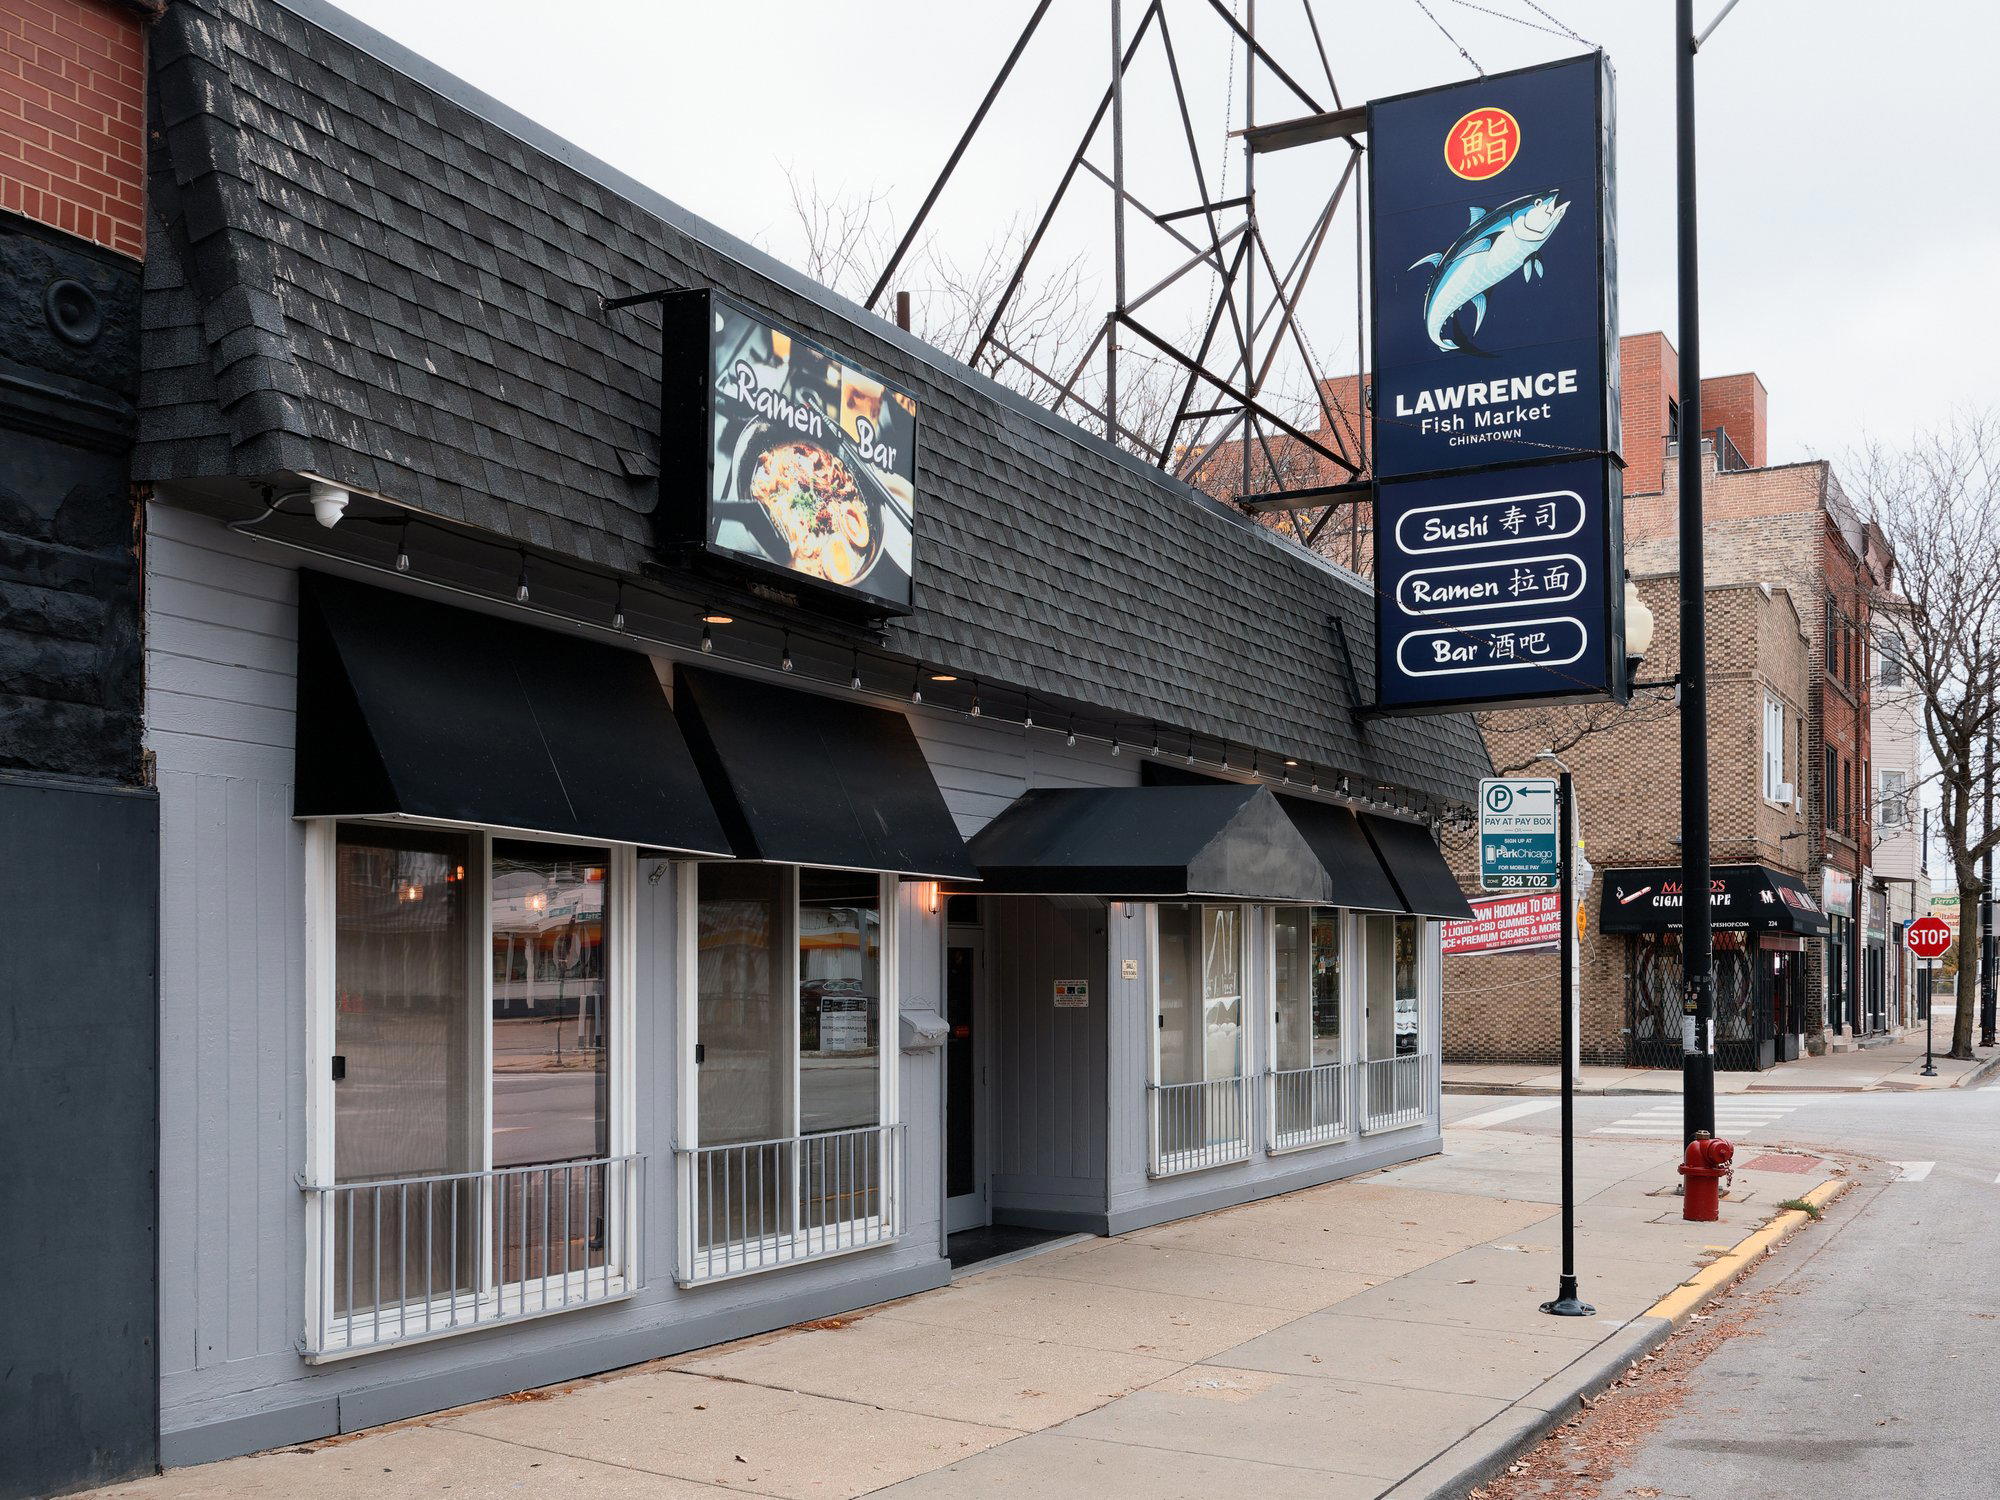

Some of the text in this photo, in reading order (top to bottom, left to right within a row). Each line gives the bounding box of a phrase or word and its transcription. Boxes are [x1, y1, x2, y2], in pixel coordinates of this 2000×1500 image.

[1459, 116, 1509, 170] 鮨
[1396, 369, 1578, 417] LAWRENCE
[736, 361, 897, 470] Ramen Bar
[1421, 402, 1551, 435] Fish Market
[1449, 429, 1522, 447] CHINATOWN
[1423, 502, 1556, 542] Sushi 寿司
[1412, 565, 1570, 602] Ramen 拉面
[1432, 632, 1550, 663] Bar 酒吧
[1494, 790, 1507, 807] P
[1501, 876, 1523, 887] 284
[1526, 876, 1548, 887] 702
[1494, 902, 1528, 919] HOOKAH
[1529, 899, 1540, 912] TO
[1541, 896, 1557, 911] GO!
[1709, 894, 1731, 906] APE
[1448, 925, 1474, 937] LIQUID
[1479, 922, 1496, 932] CBD
[1498, 915, 1535, 929] GUMMIES
[1461, 932, 1499, 945] PREMIUM
[1500, 926, 1529, 939] CIGARS
[1531, 925, 1538, 934] &
[1539, 922, 1561, 933] MORE
[1909, 929, 1949, 945] STOP
